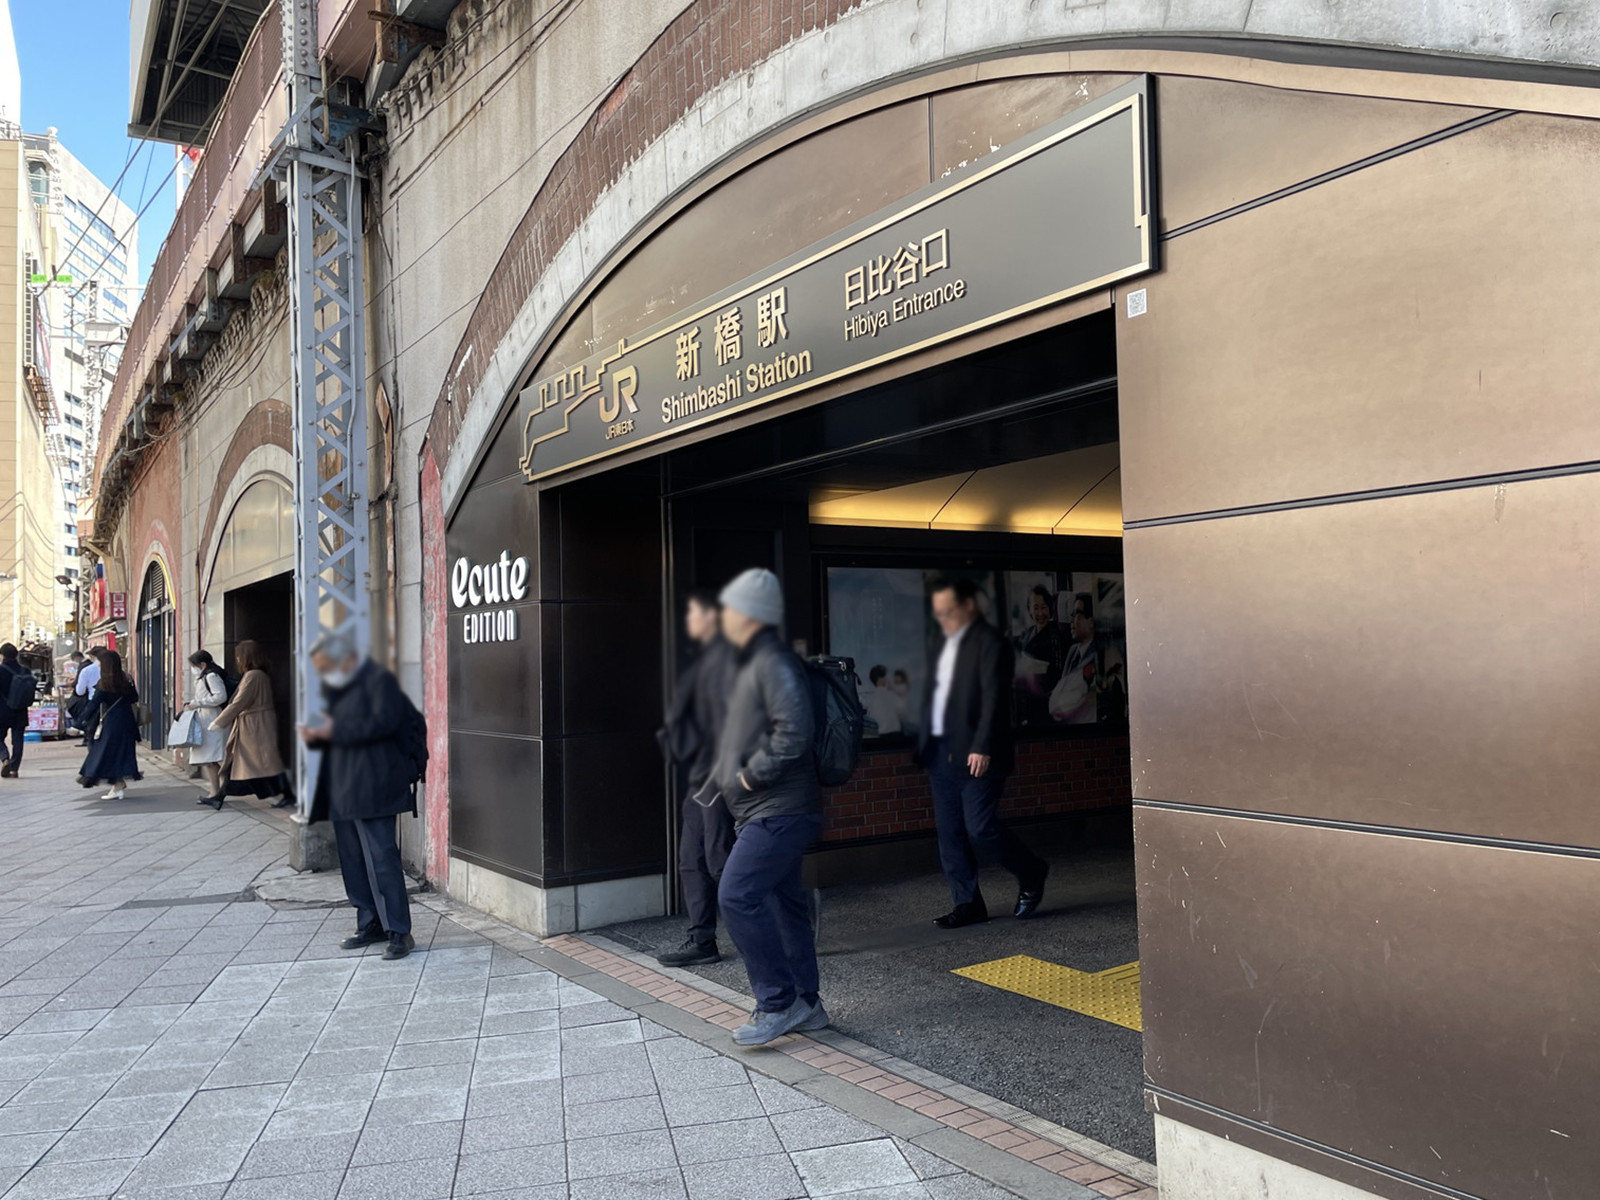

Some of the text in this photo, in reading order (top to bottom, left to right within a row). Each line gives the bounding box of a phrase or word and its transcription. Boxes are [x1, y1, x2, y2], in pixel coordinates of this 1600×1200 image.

[844, 227, 949, 311] 日比谷口
[675, 286, 789, 382] 新橋駅
[843, 278, 966, 341] Hibiya Entrance
[599, 365, 640, 423] JR
[661, 349, 813, 424] Shimbashi Station
[451, 549, 528, 609] ecute
[463, 608, 517, 644] EDITION
